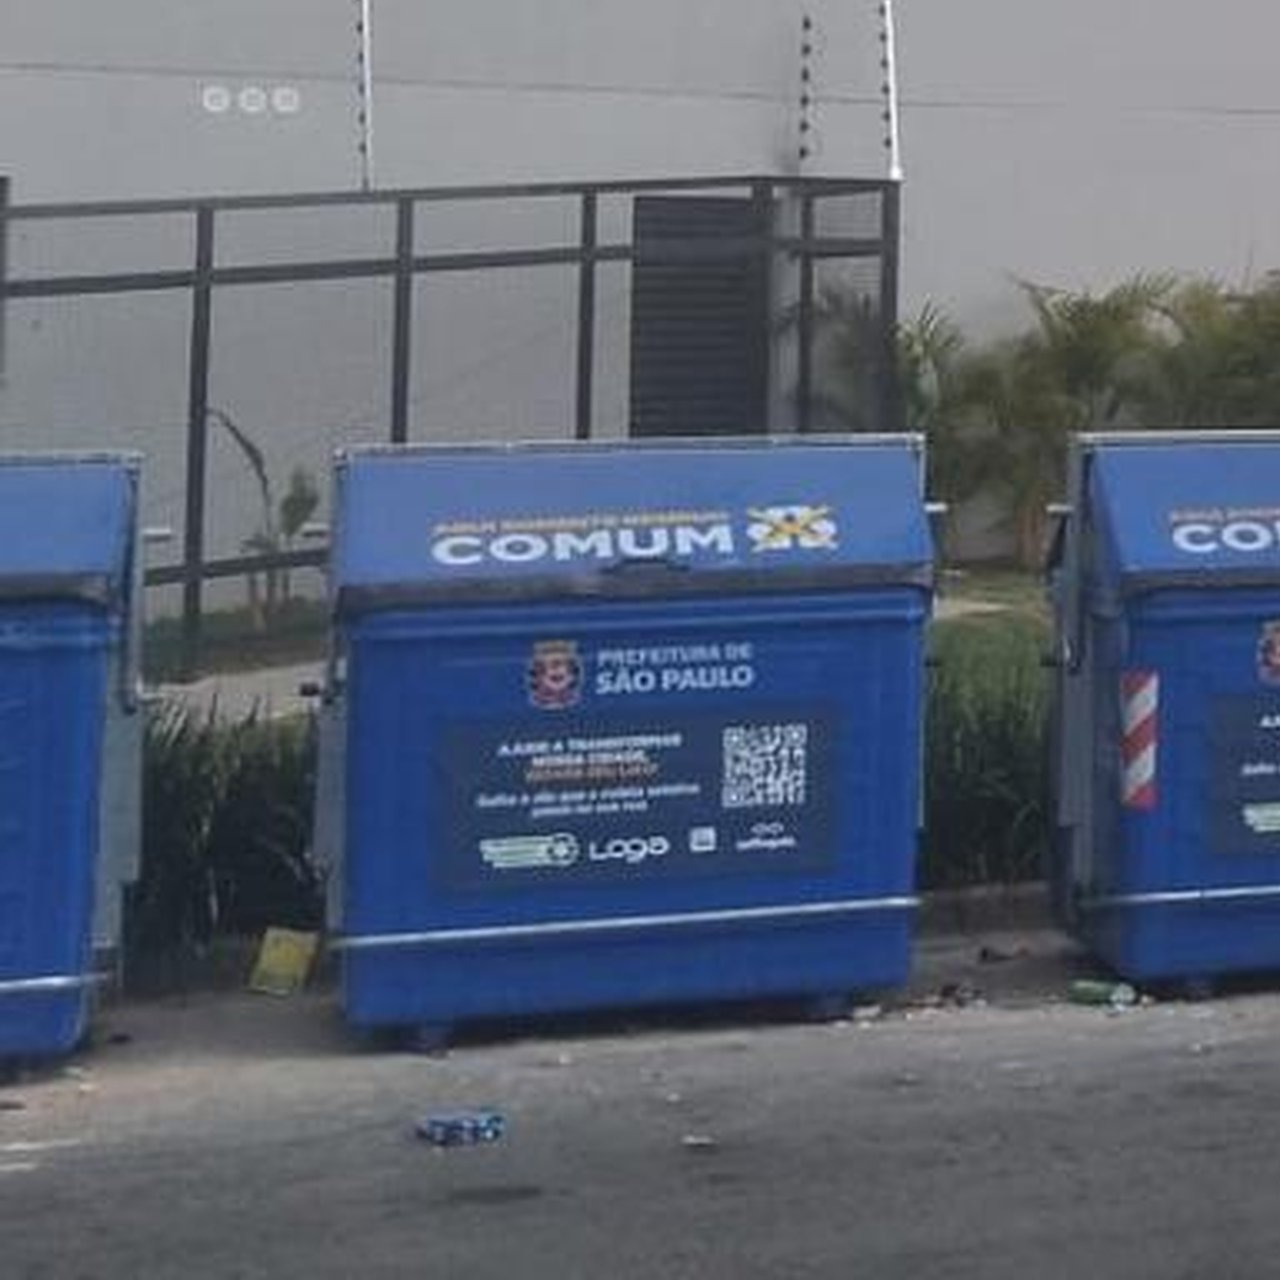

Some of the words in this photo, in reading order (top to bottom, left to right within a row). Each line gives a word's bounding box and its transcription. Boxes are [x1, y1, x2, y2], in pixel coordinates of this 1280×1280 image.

[431, 524, 735, 565] COMUM
[598, 644, 721, 667] PREFEITURA
[595, 667, 656, 695] SÃO
[662, 666, 755, 692] PAULO
